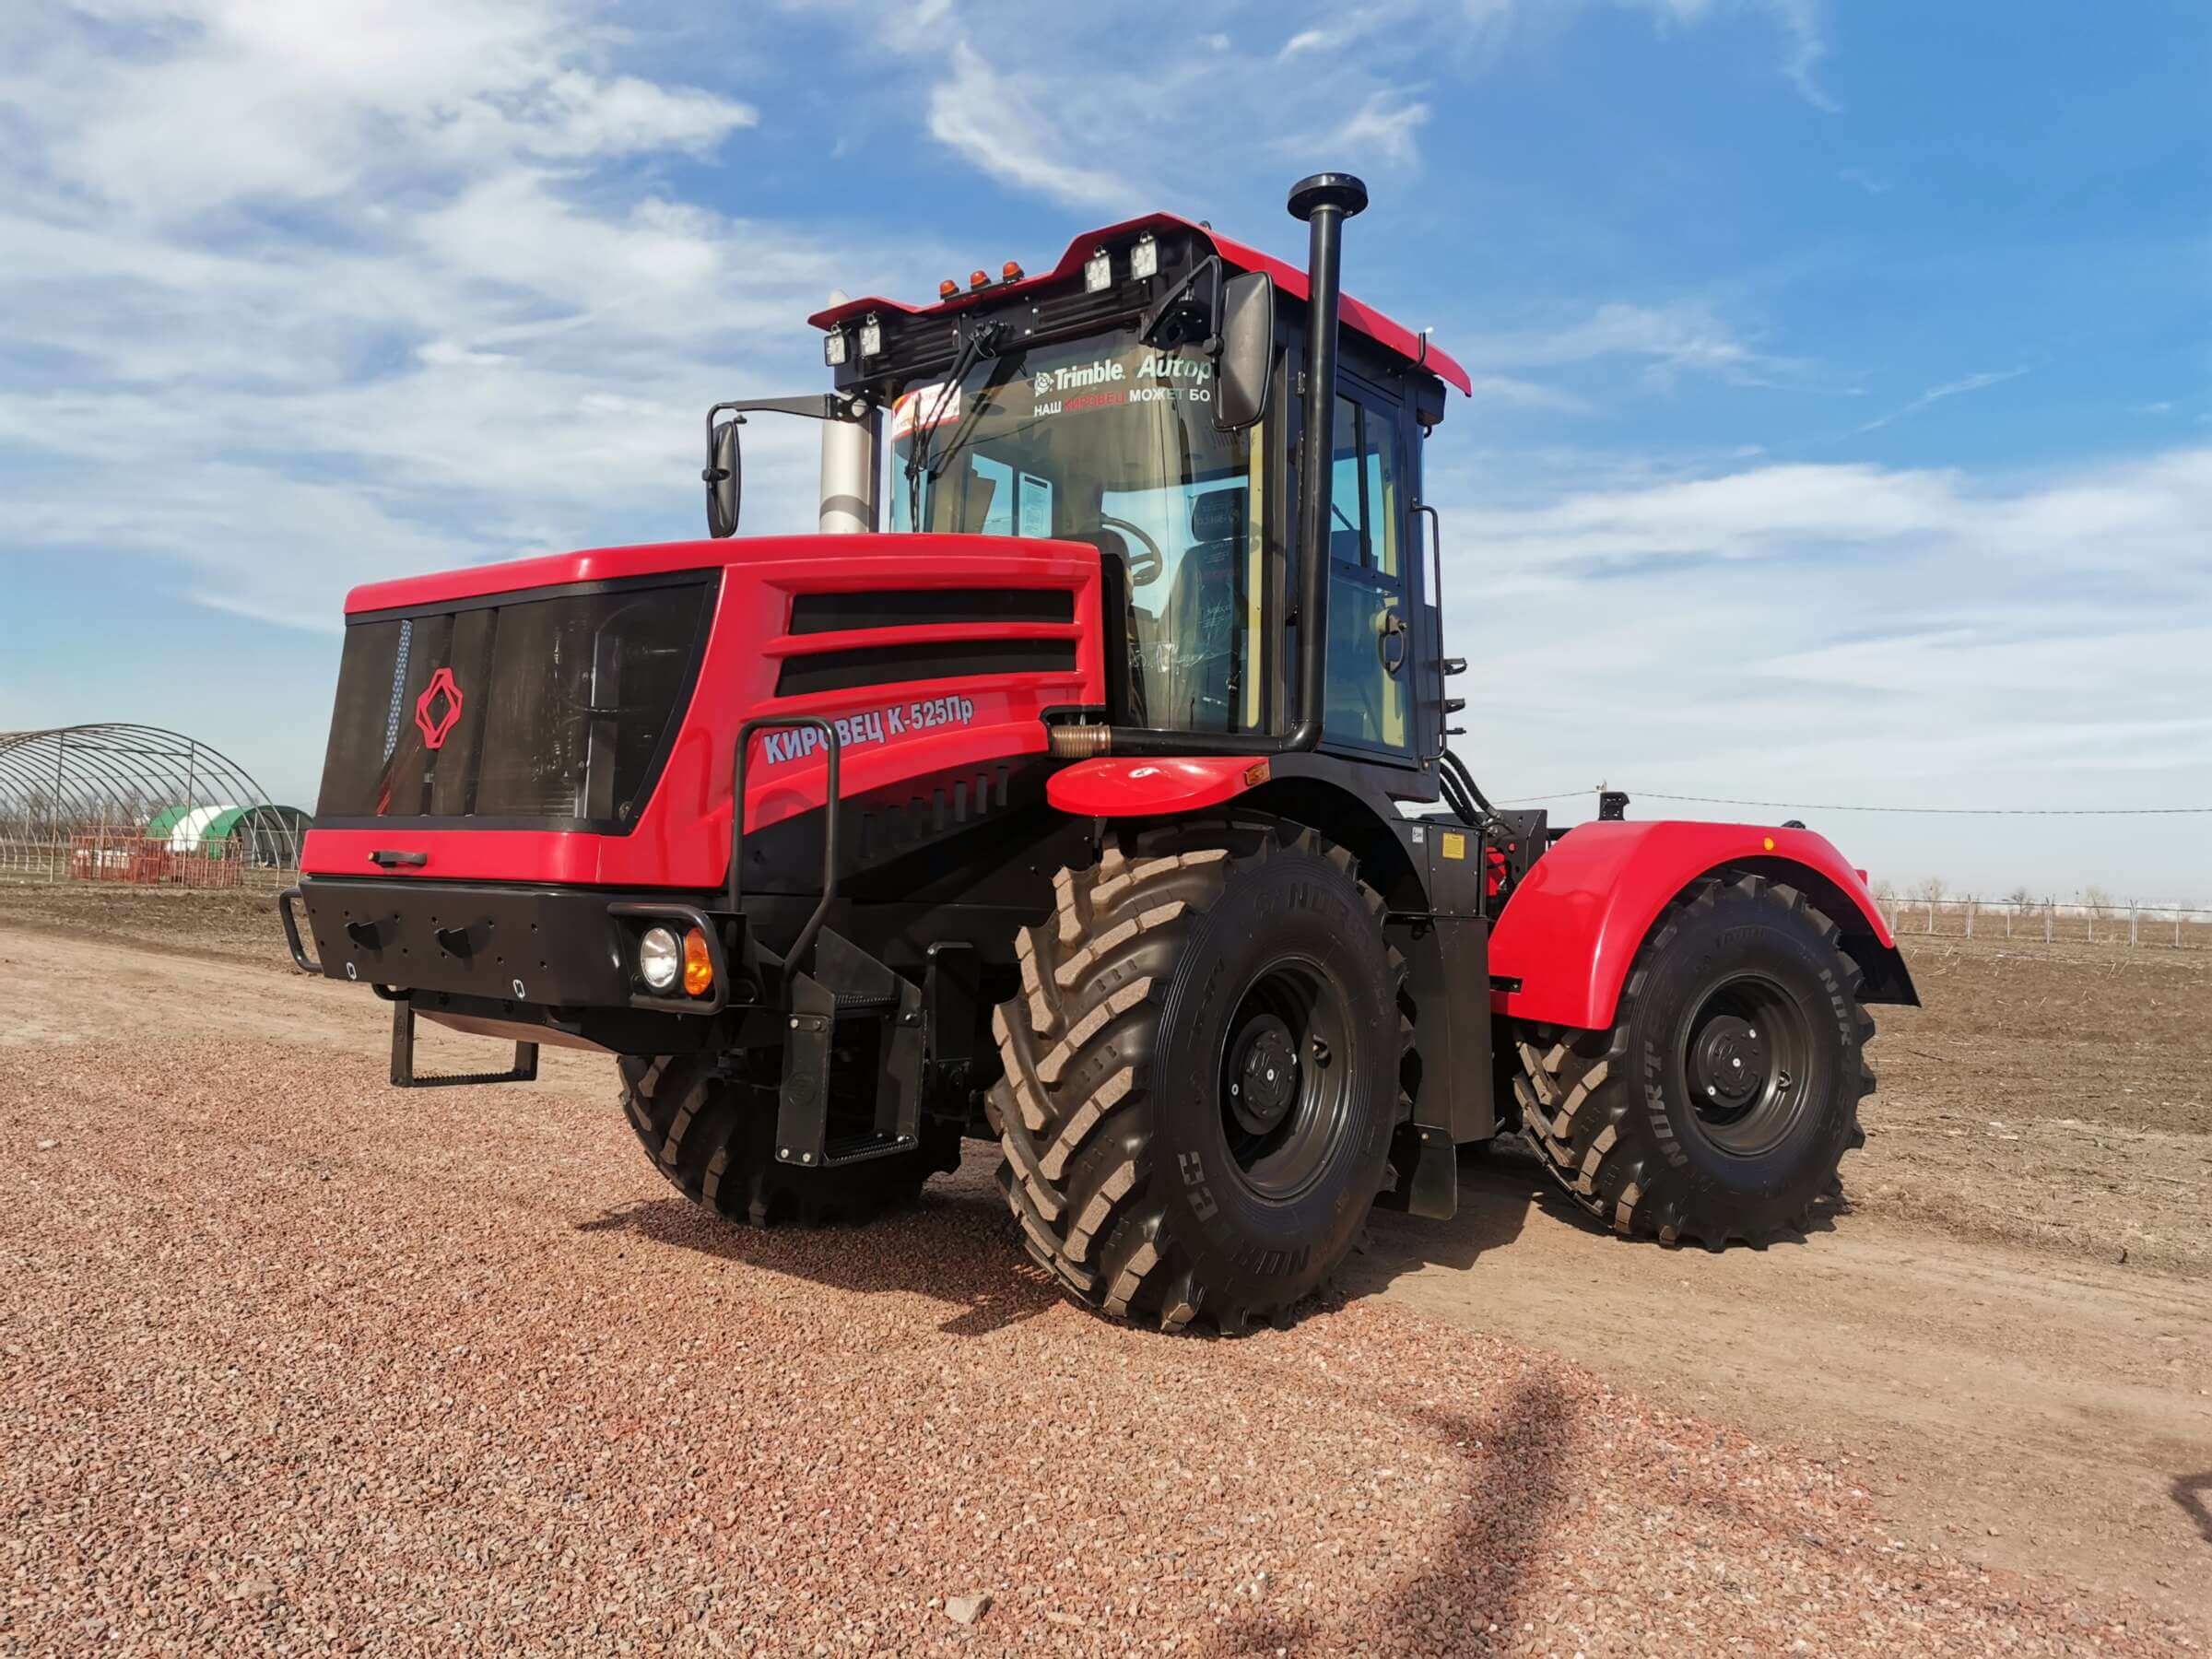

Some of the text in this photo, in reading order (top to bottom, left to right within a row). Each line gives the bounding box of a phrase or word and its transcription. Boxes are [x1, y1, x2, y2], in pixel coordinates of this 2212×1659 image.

[1054, 359, 1124, 391] Trimble
[1033, 401, 1062, 418] НАШ
[1129, 388, 1186, 403] МОЖЕТ
[887, 695, 974, 735] К-525Пр
